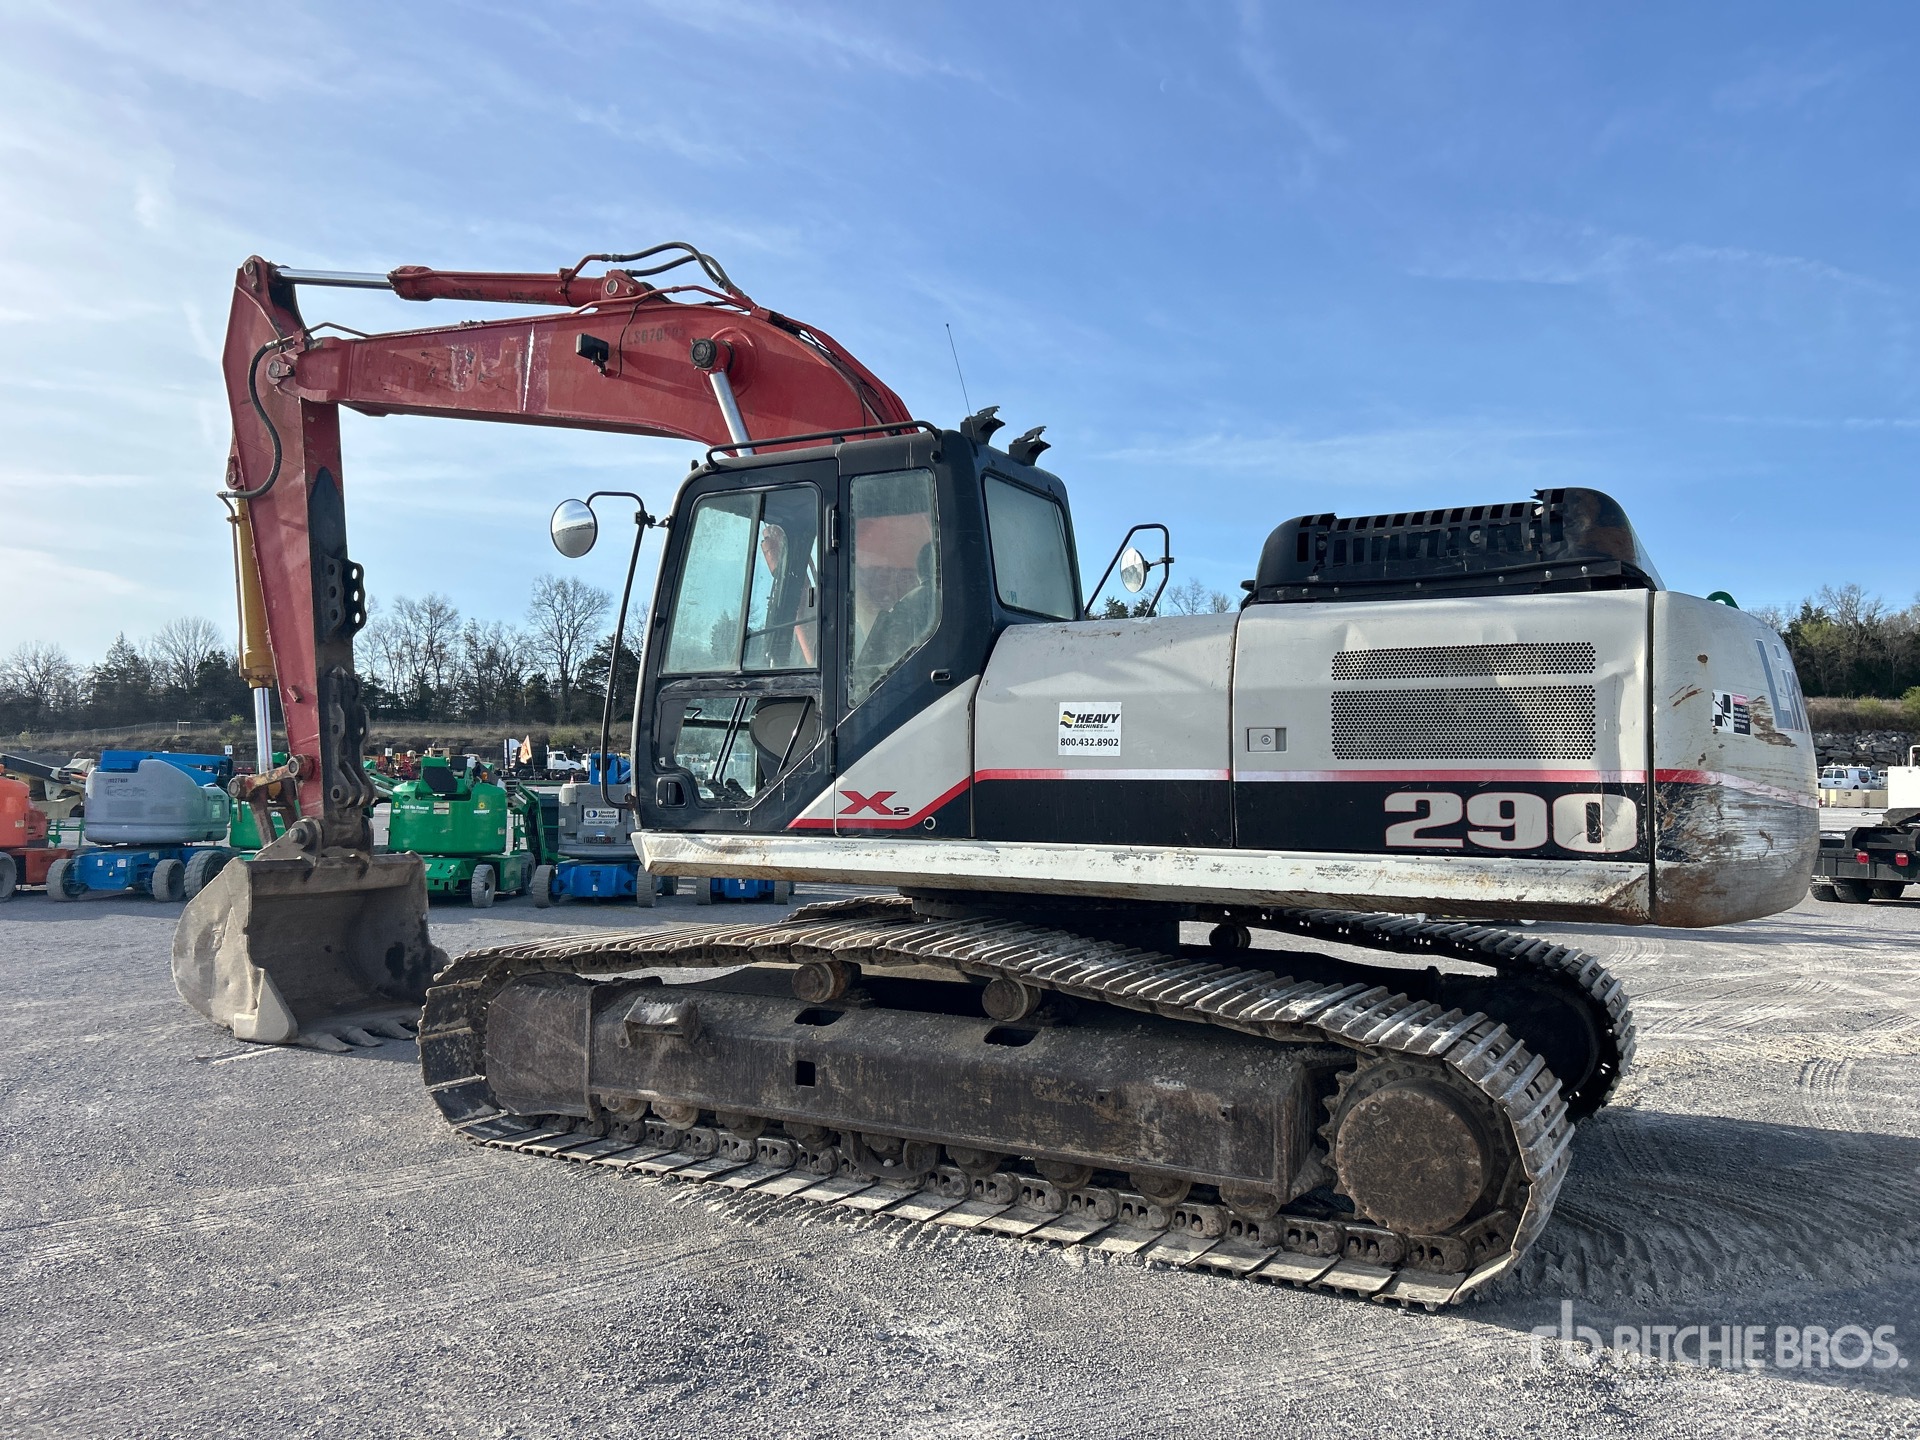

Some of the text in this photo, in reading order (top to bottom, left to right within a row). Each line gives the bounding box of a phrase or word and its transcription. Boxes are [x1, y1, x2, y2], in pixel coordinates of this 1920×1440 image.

[1075, 713, 1120, 724] HEAVY
[1060, 737, 1119, 747] 800.432.8902
[837, 790, 910, 816] X2
[1384, 791, 1638, 853] 290
